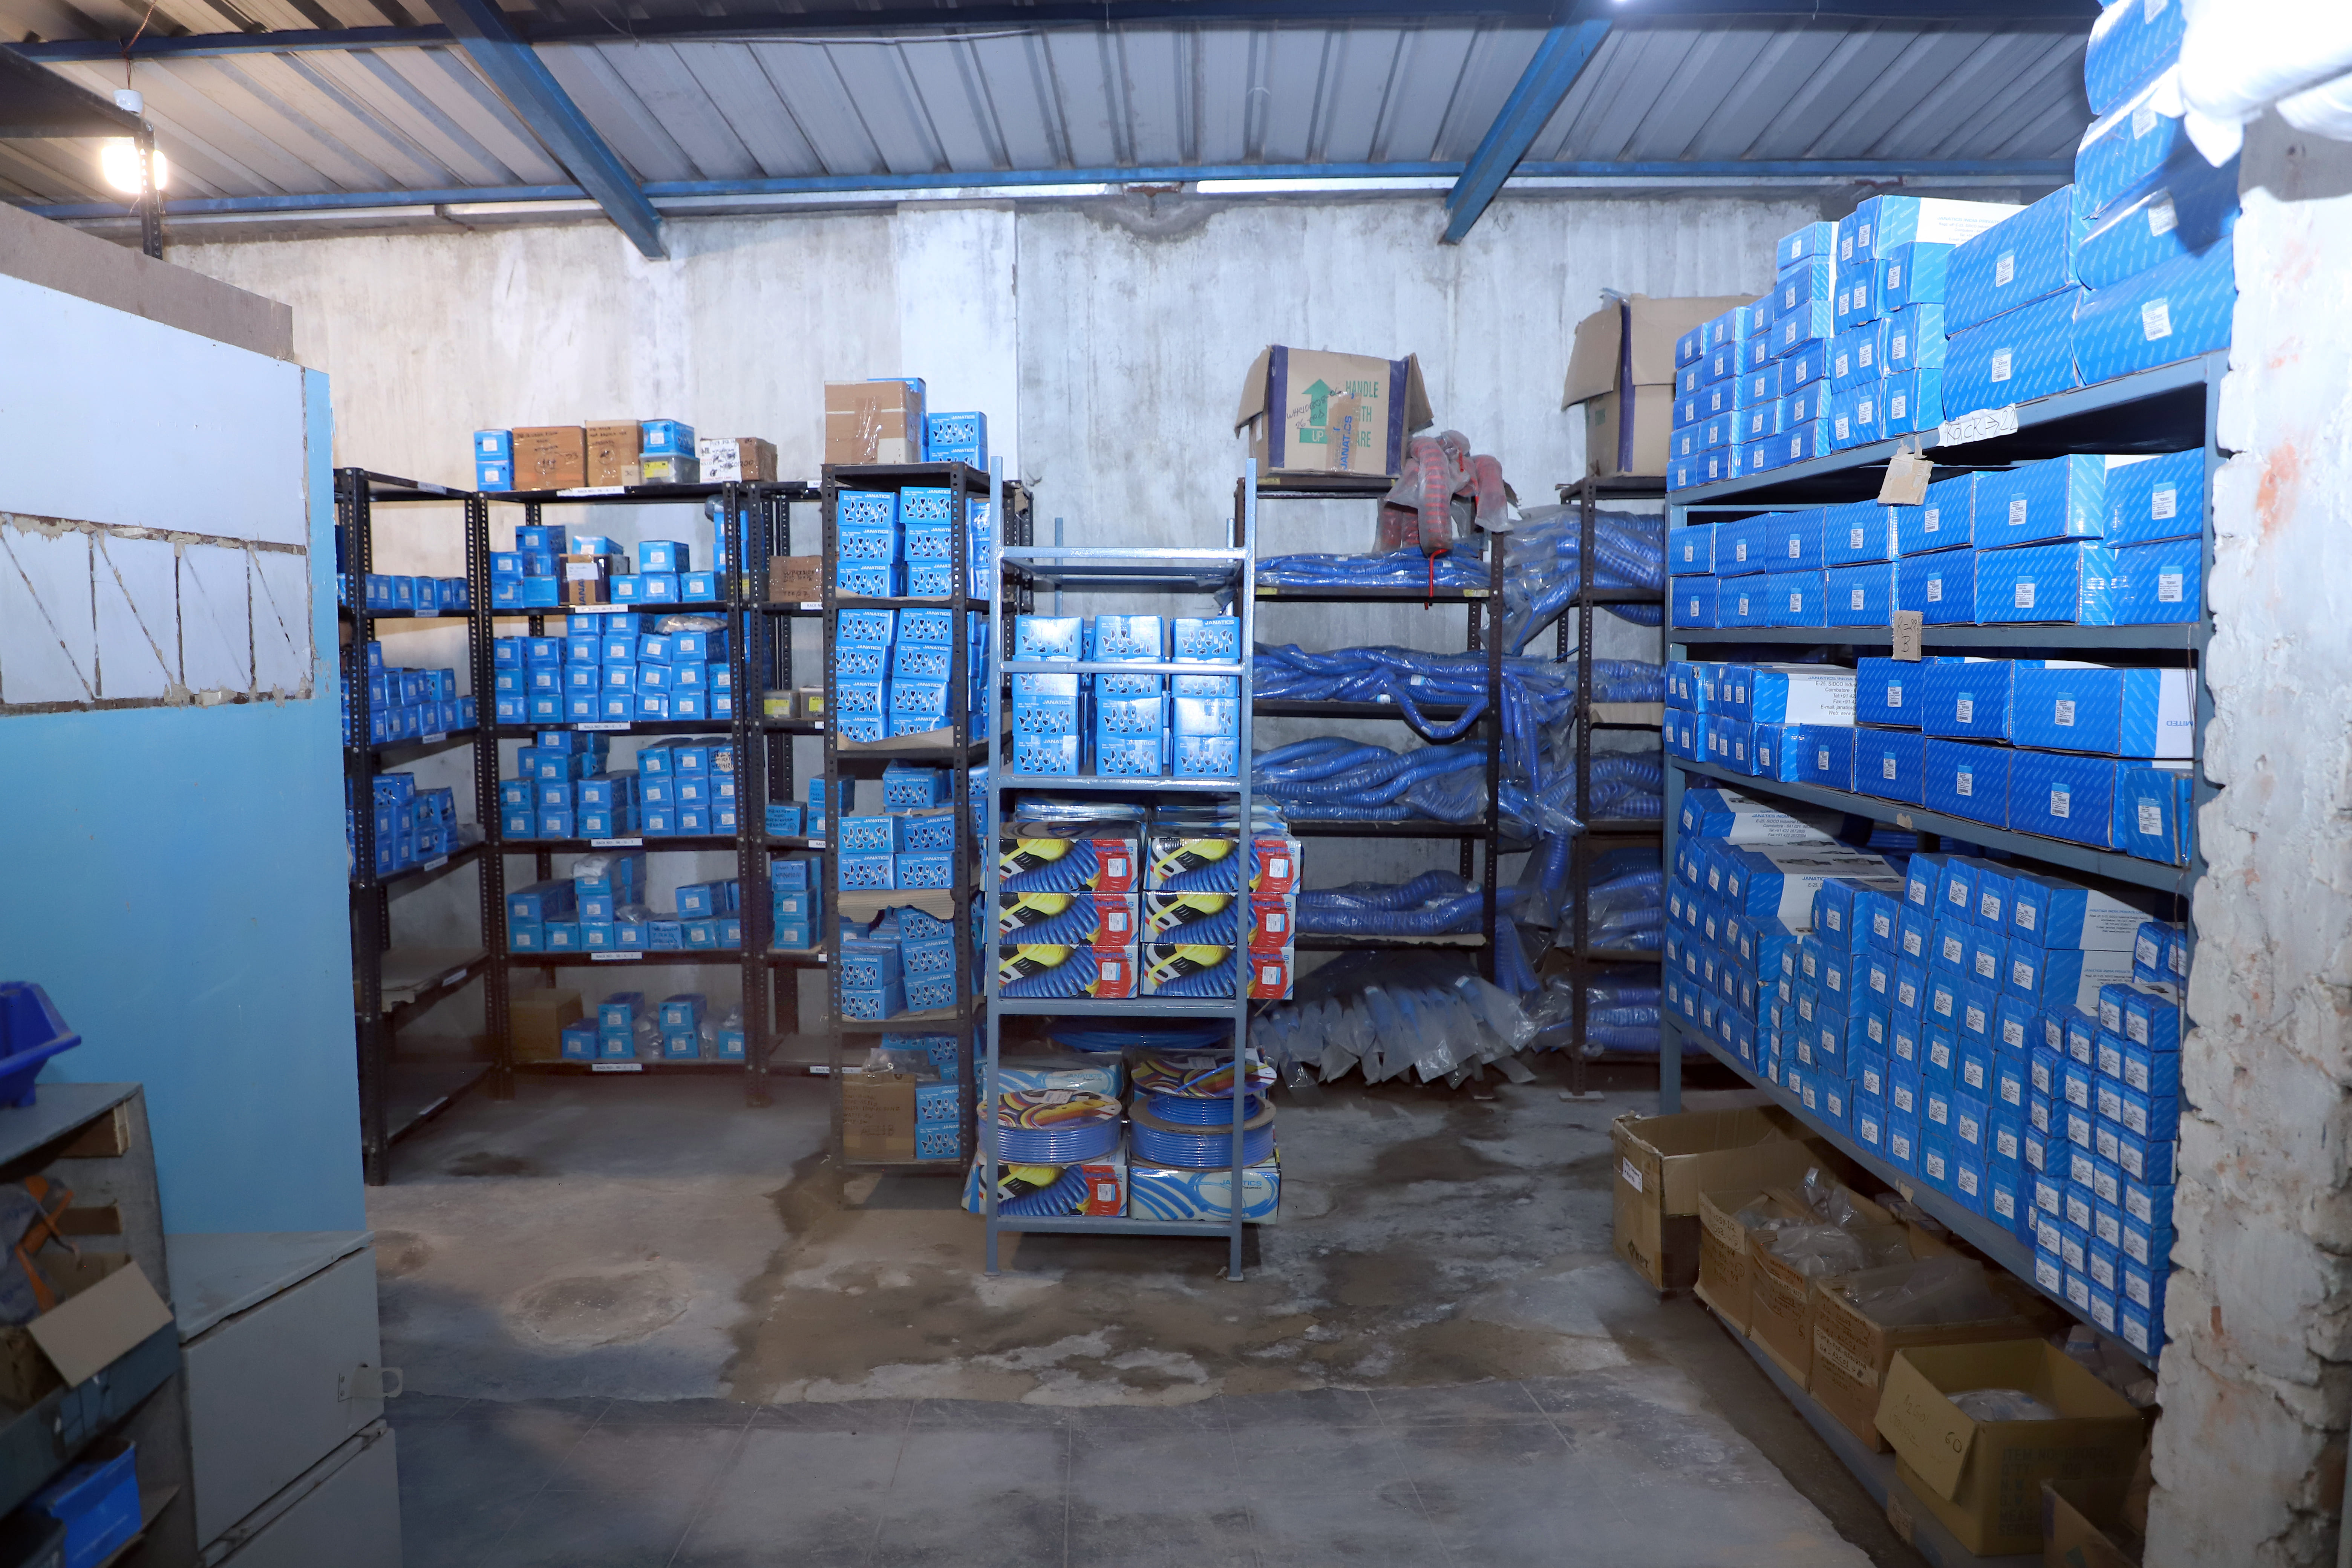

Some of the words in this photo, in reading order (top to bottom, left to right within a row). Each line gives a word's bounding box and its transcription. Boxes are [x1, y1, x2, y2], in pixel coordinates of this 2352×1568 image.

[1346, 381, 1378, 398] HANDLE
[1312, 430, 1324, 441] UP
[2002, 1448, 2032, 1461] ITEM
